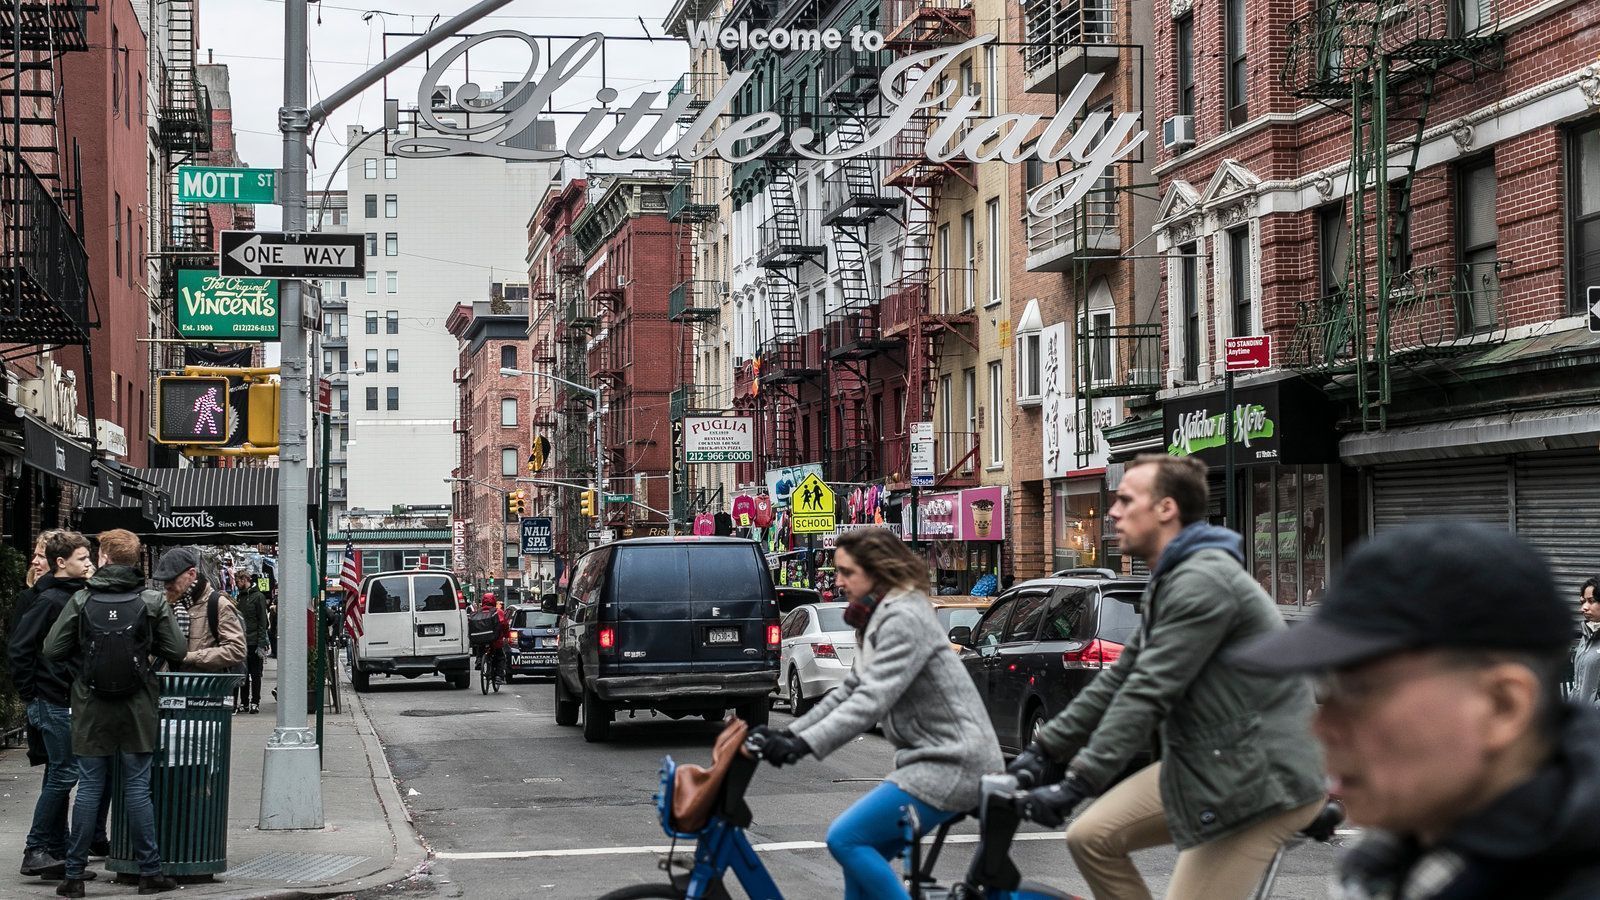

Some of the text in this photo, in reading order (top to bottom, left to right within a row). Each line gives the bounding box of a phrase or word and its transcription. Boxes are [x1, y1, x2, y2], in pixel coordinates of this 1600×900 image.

[685, 19, 885, 52] Welcome to
[392, 29, 1150, 218] Little Italy
[183, 172, 273, 198] MOTT ST
[243, 245, 346, 264] ONE WAY
[202, 276, 271, 298] The Original
[1236, 339, 1264, 348] STANDING
[1227, 348, 1250, 356] Anytime
[691, 419, 748, 435] PUGLIA
[689, 451, 751, 461] 212-966-6006
[218, 520, 237, 528] Since
[238, 520, 254, 528] 1904
[795, 519, 832, 529] SCHOOL
[523, 526, 550, 537] NAIL
[527, 536, 547, 547] SPA
